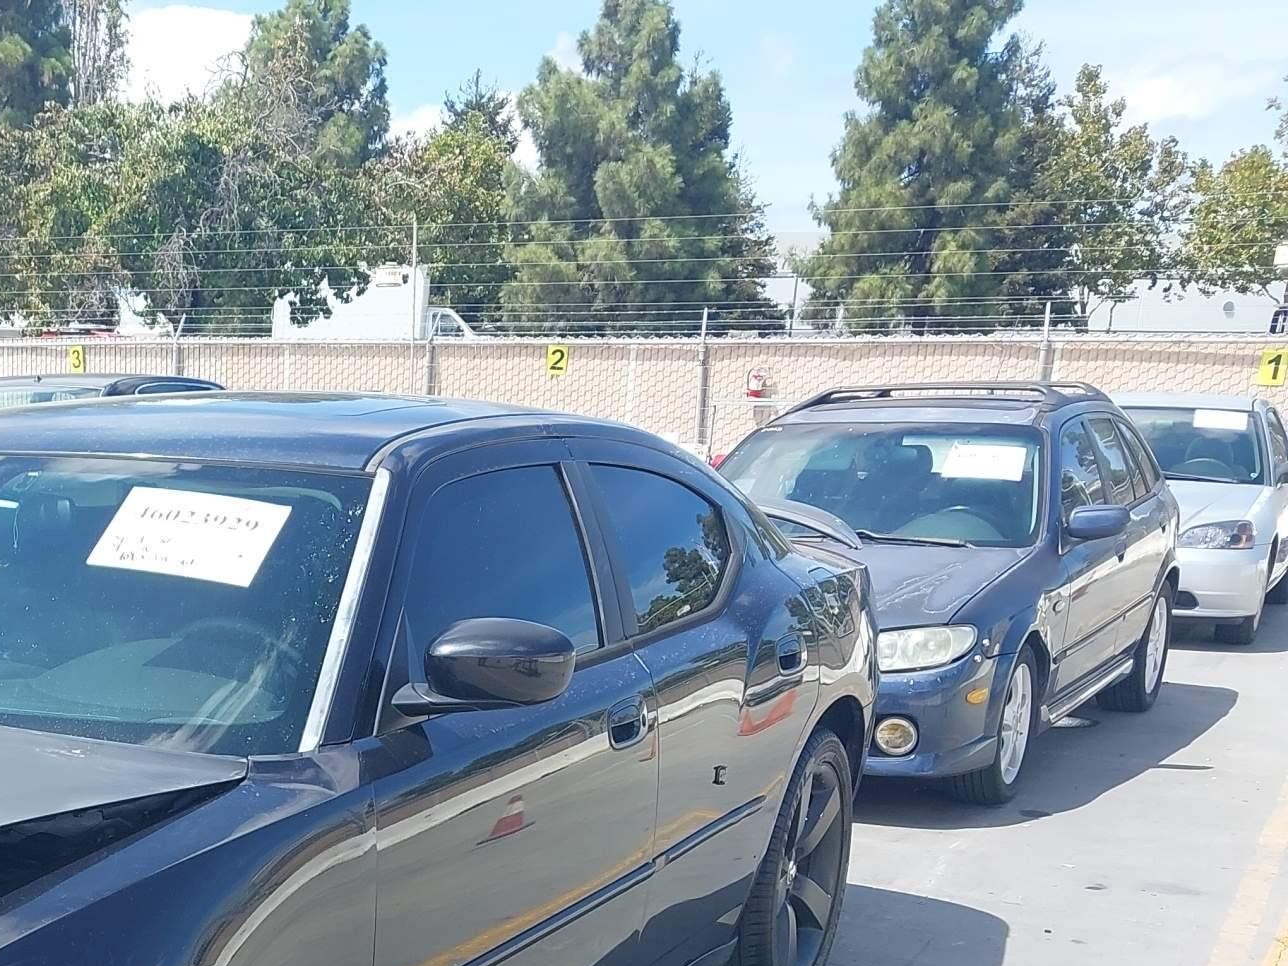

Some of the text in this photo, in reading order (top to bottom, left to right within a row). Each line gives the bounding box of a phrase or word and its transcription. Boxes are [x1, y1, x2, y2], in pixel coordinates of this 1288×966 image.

[71, 349, 82, 369] 3
[549, 348, 565, 371] 2
[1267, 353, 1283, 381] 1
